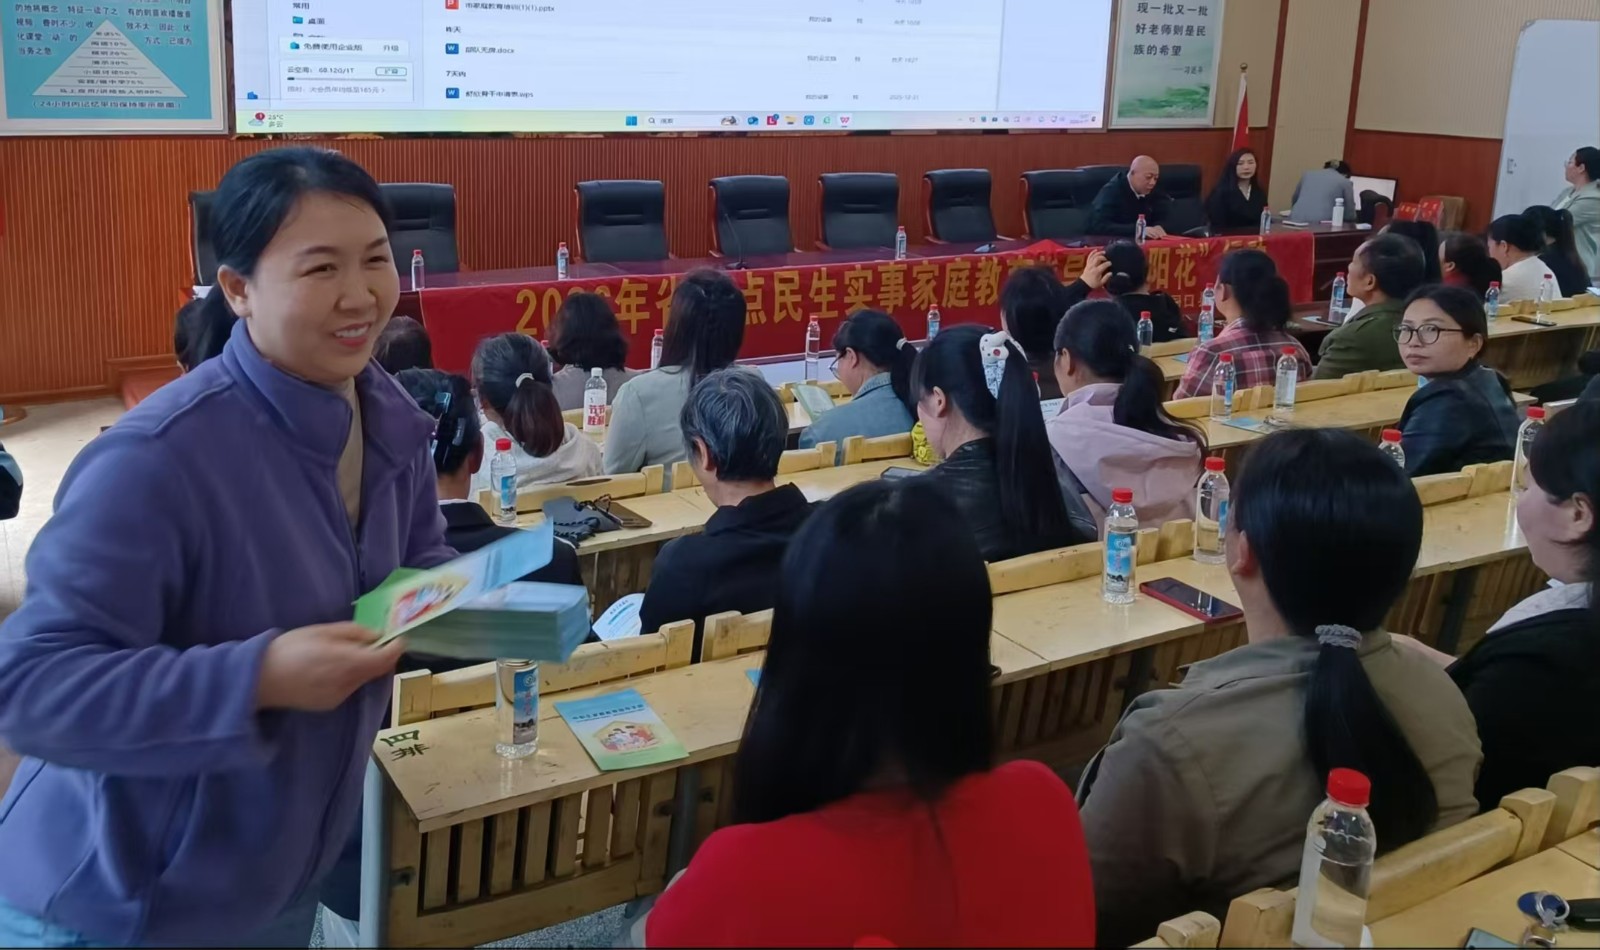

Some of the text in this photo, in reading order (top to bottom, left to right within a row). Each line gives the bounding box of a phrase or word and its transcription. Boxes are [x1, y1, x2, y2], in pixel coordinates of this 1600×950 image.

[1137, 3, 1208, 16] 现一批又一批
[308, 17, 325, 25] 桌面
[1136, 23, 1206, 36] 好老师则是民
[1133, 44, 1182, 56] 族的希望
